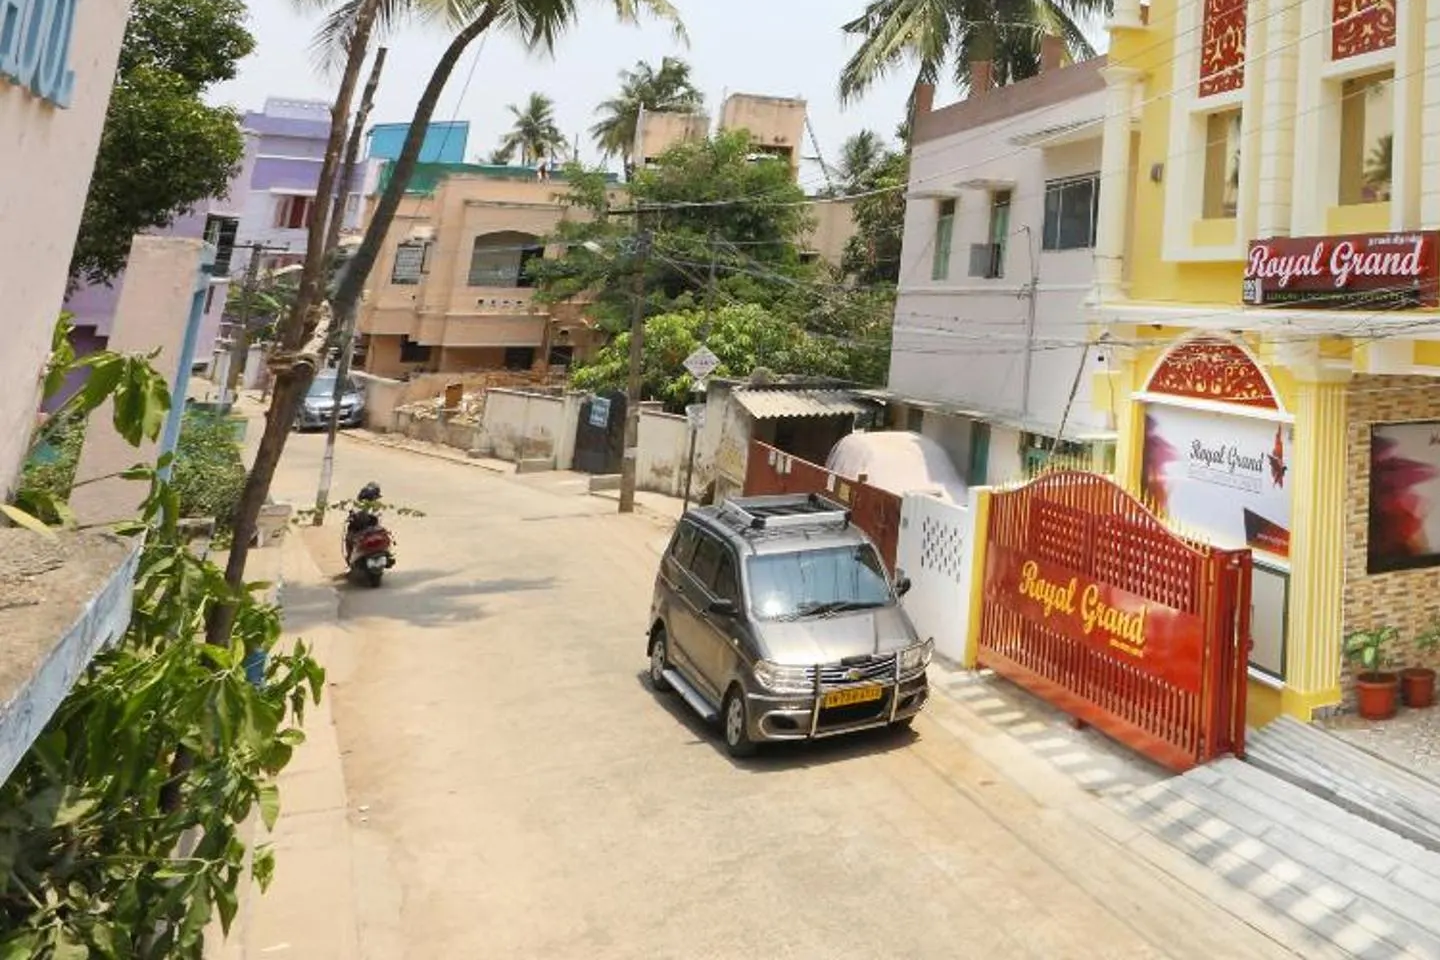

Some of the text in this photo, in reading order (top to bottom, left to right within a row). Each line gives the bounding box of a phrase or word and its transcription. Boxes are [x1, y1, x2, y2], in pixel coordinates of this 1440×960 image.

[1245, 237, 1423, 288] Royal Grand
[1189, 439, 1265, 473] Royal Grand
[1019, 560, 1148, 645] Royal Grand
